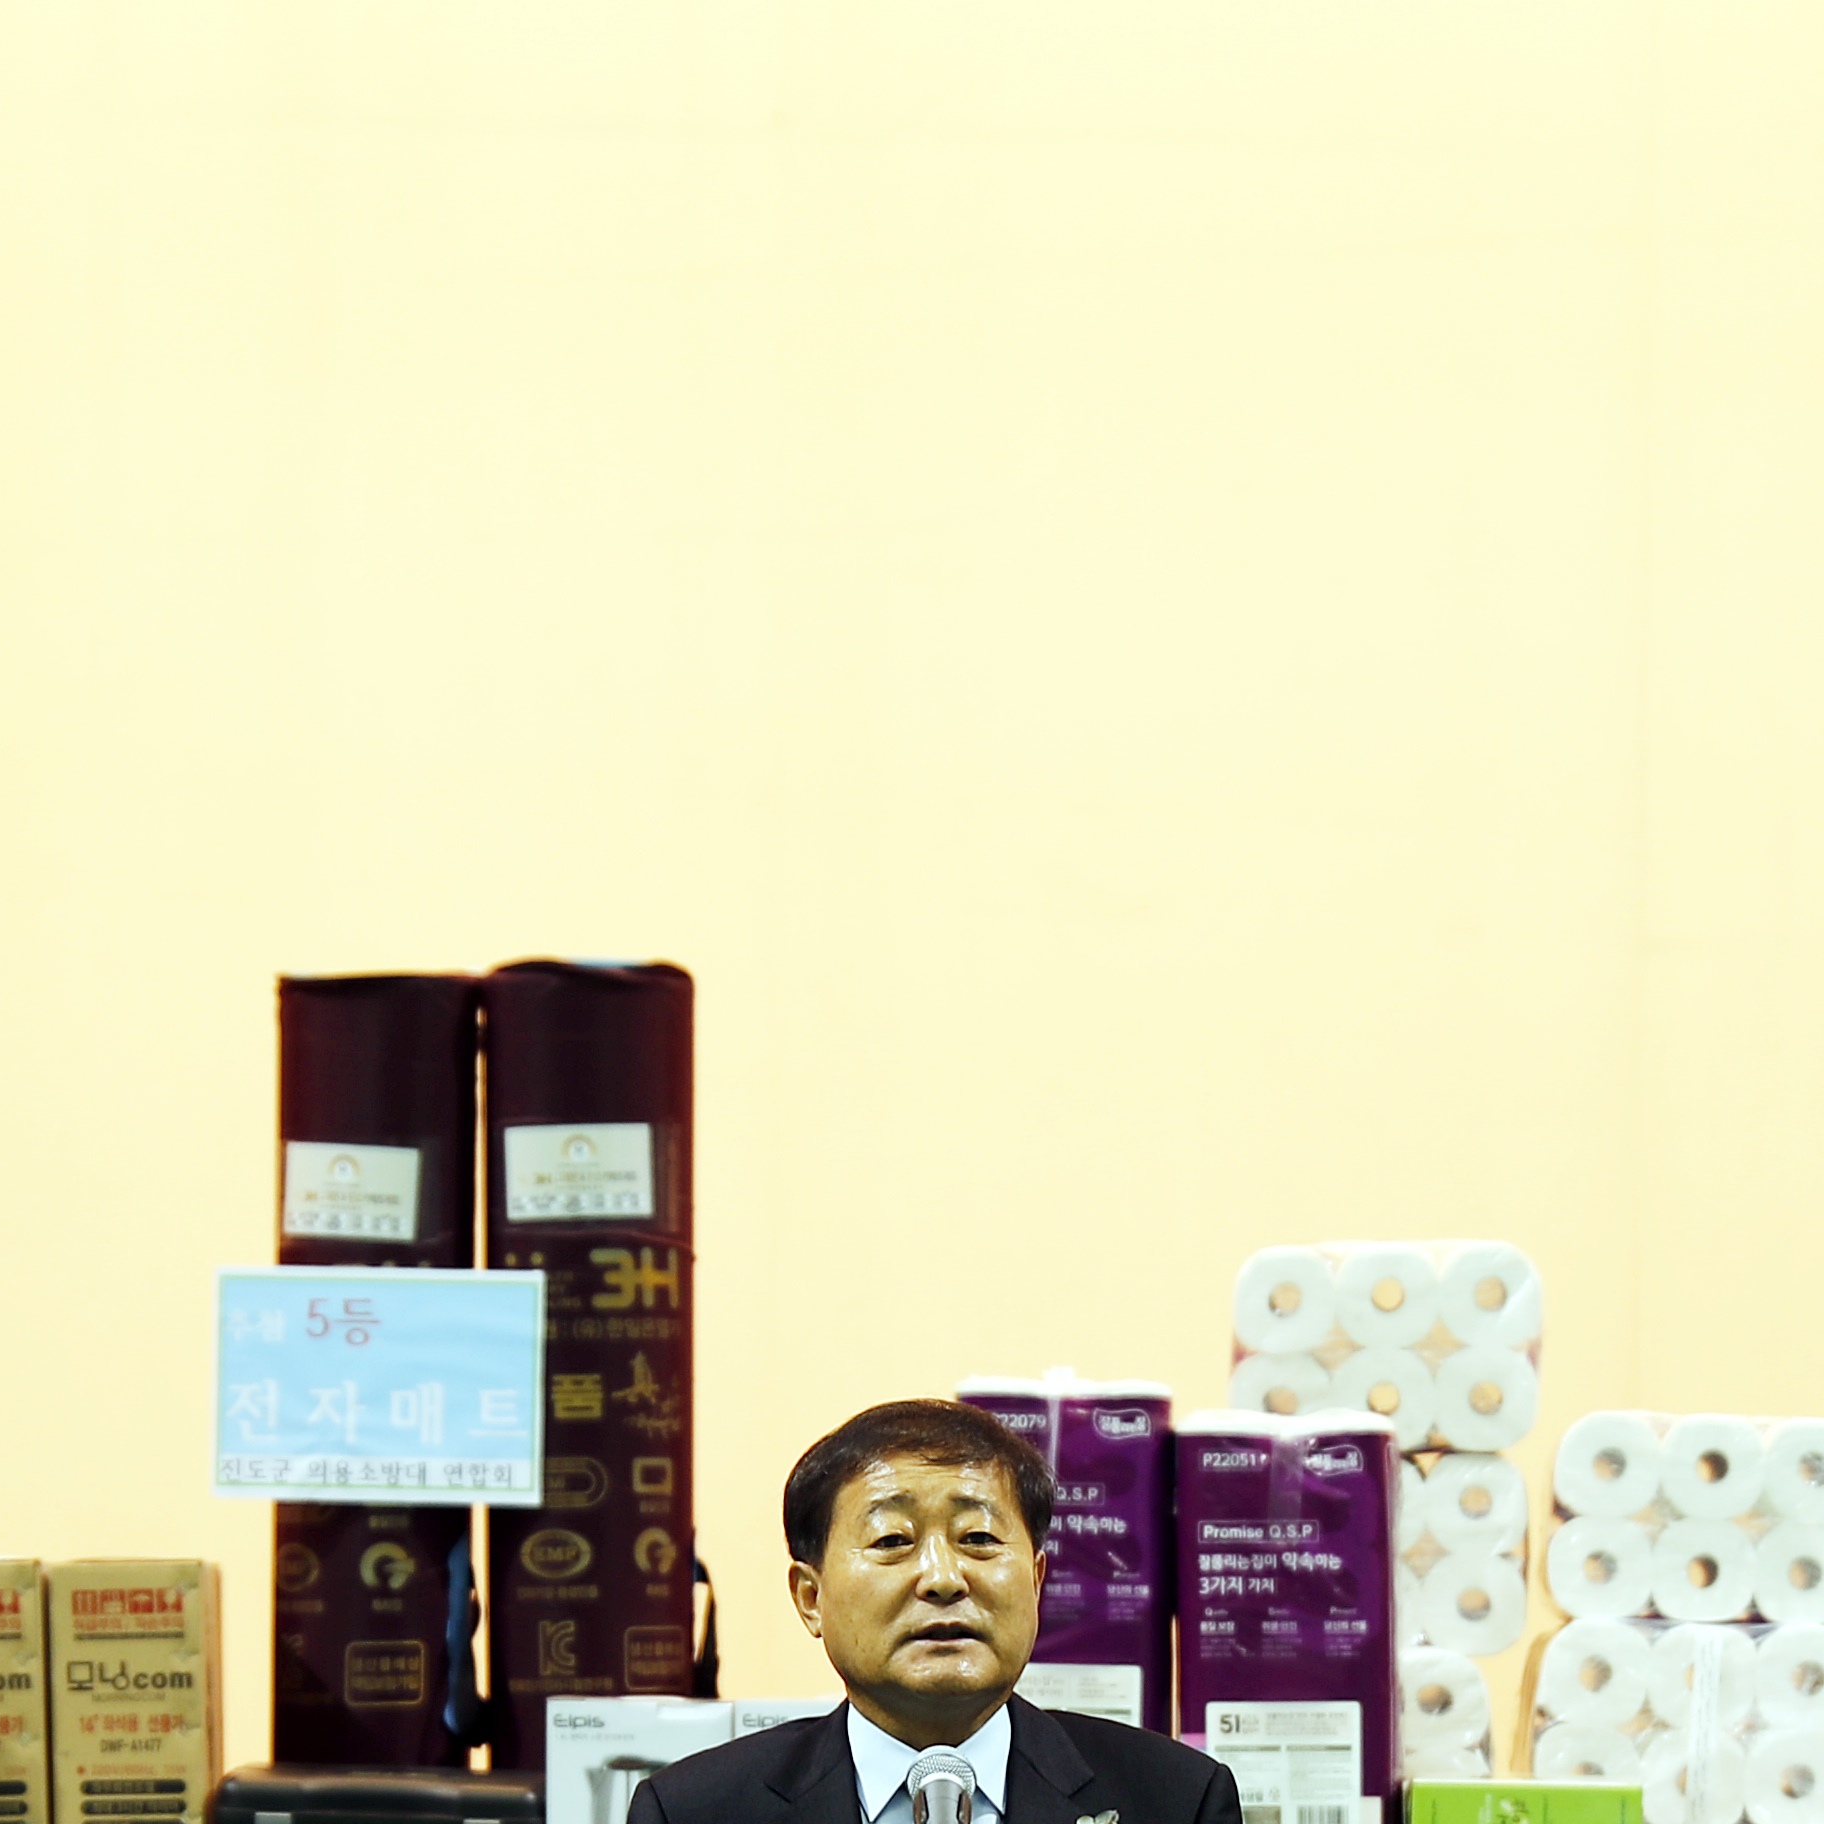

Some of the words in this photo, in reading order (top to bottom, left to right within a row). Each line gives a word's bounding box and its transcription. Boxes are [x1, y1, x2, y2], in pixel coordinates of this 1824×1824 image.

[305, 1298, 382, 1347] 5등
[227, 1379, 529, 1446] 전자매트
[996, 1413, 1046, 1428] 22079
[220, 1458, 291, 1483] 진도군
[308, 1461, 427, 1486] 의용소방대
[443, 1463, 513, 1489] 연합회
[1067, 1515, 1126, 1534] 약속하는
[1203, 1525, 1263, 1539] Promise
[1269, 1525, 1312, 1539] Q.S.P
[1282, 1553, 1342, 1570] 약속하는
[1199, 1577, 1242, 1595] 3가지
[1248, 1578, 1274, 1593] 가치
[553, 1713, 605, 1728] Elpis
